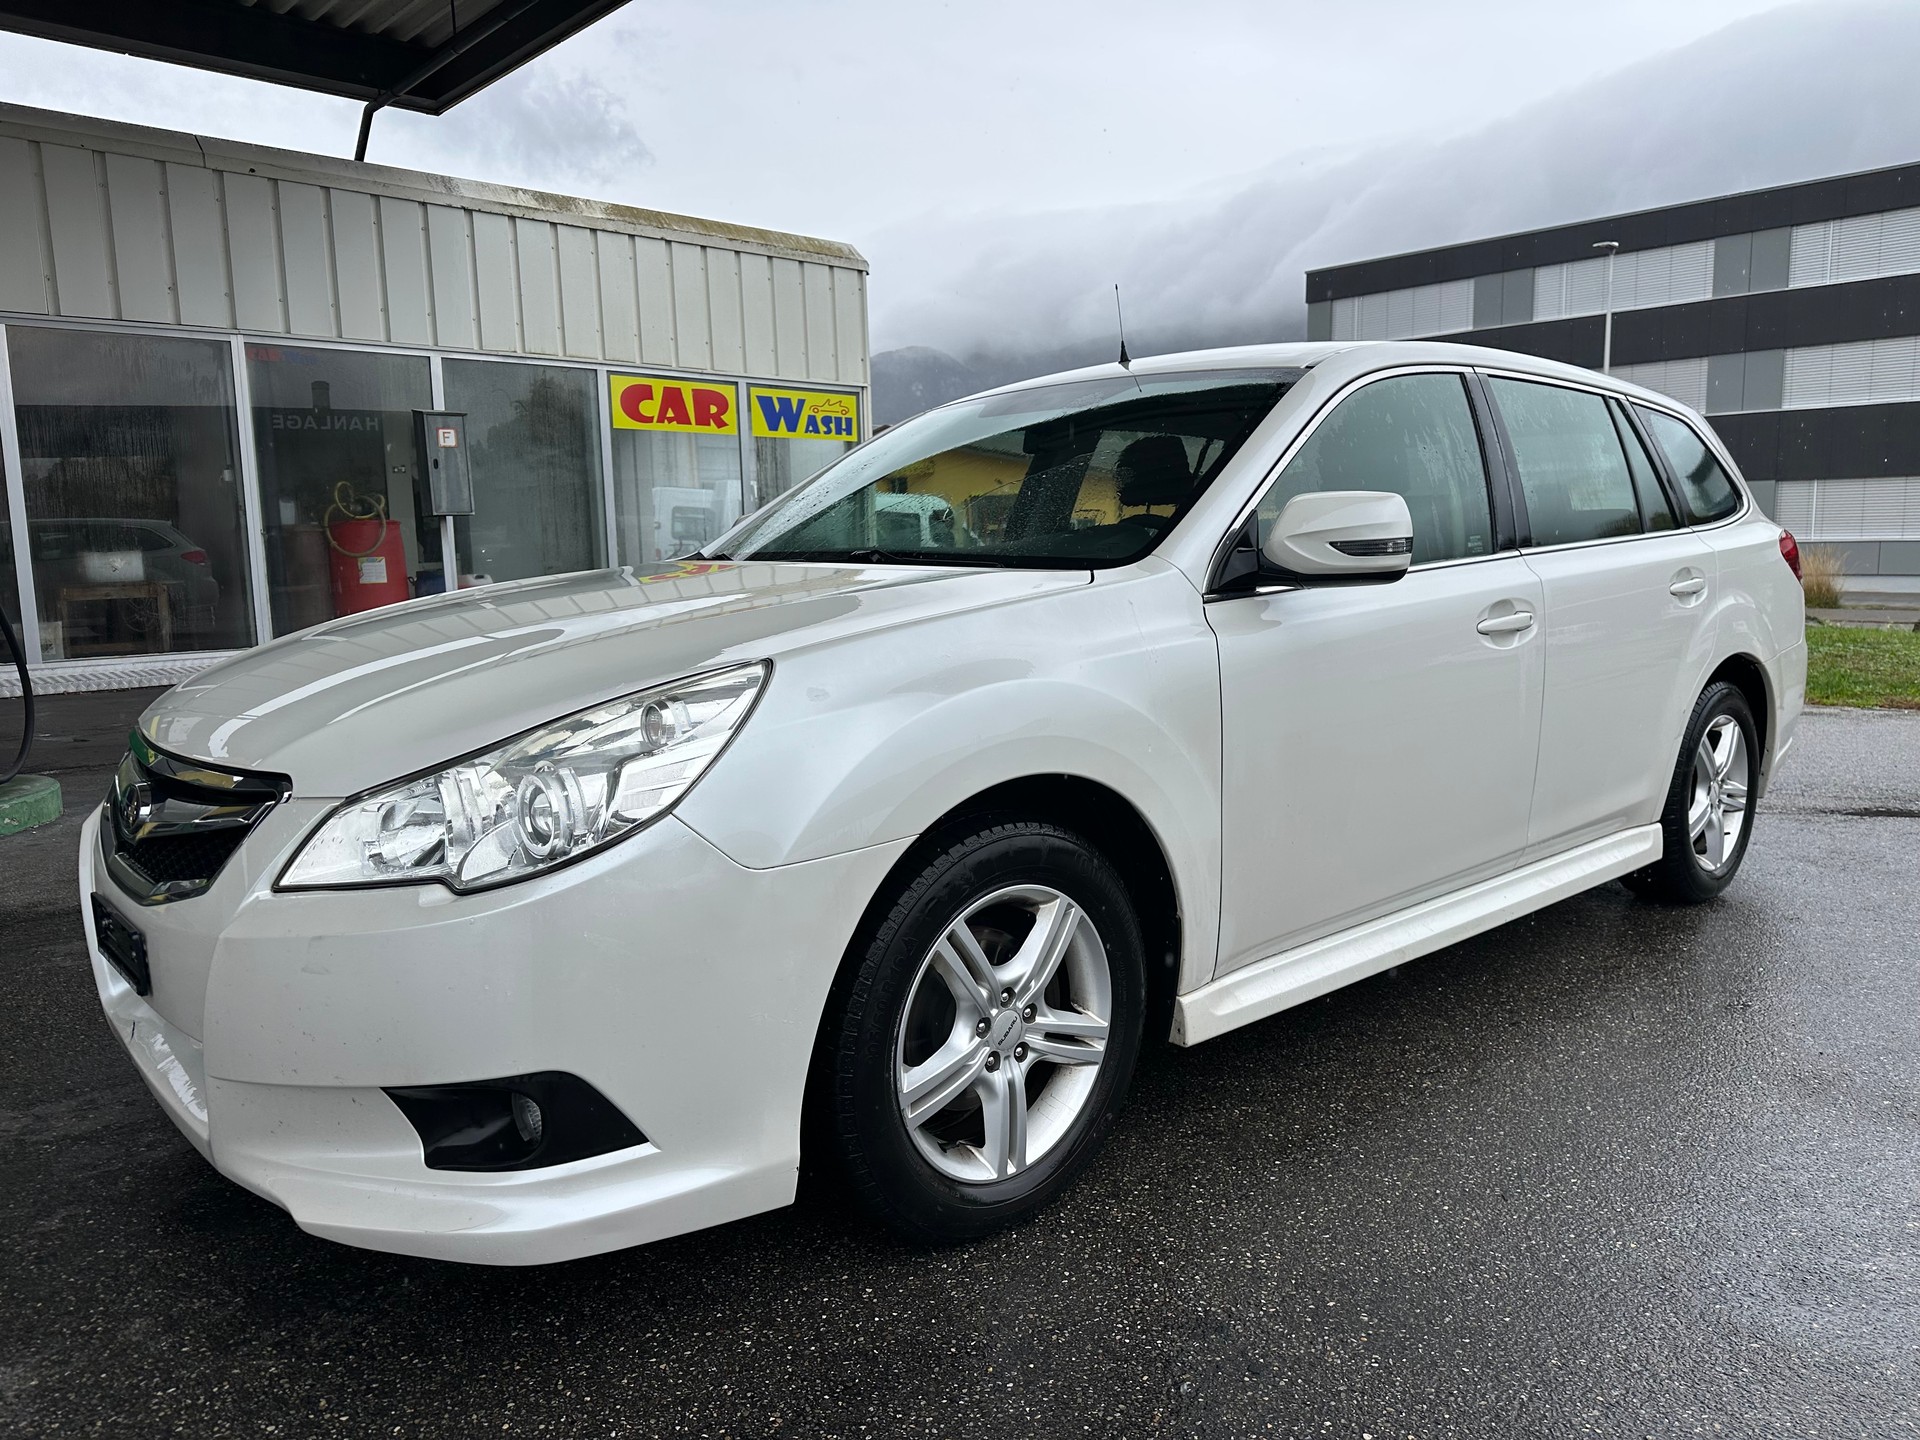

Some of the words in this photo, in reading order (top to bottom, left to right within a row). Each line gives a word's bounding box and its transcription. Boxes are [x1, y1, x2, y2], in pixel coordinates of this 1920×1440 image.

[620, 383, 729, 429] CAR
[756, 395, 853, 436] WASH
[442, 431, 451, 444] F
[997, 1015, 1018, 1047] SUBARU
